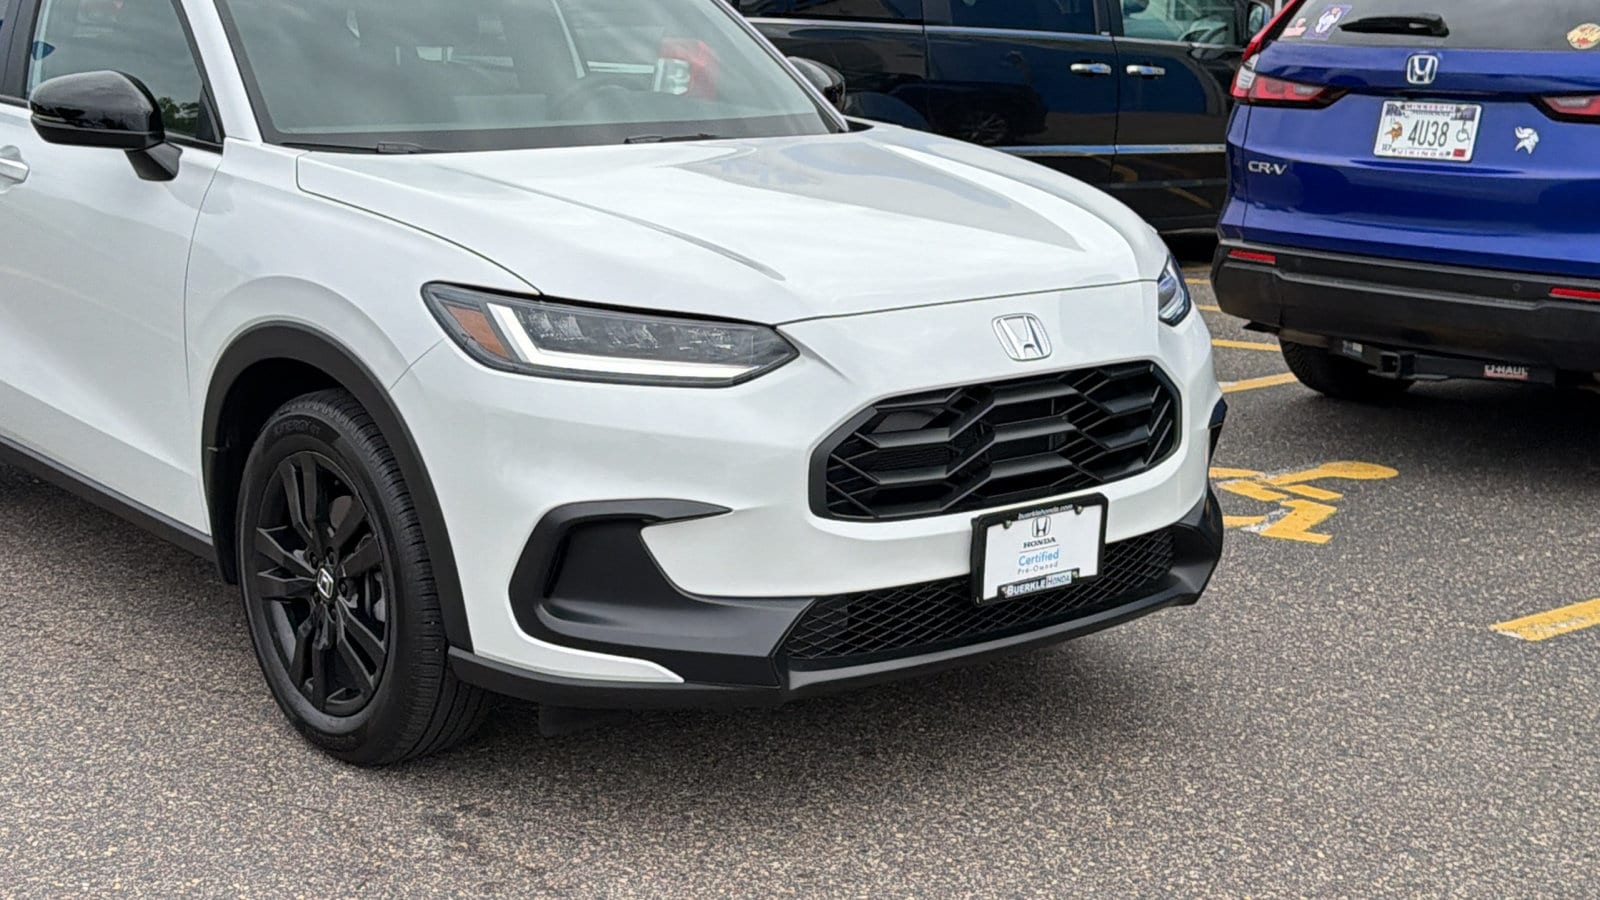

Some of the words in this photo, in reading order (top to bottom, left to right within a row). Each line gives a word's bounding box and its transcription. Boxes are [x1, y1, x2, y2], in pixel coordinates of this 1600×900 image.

[1408, 119, 1450, 147] 4U38
[1248, 160, 1287, 175] CR-V
[1024, 537, 1056, 548] HONDA
[1018, 549, 1060, 567] Certified
[1017, 562, 1059, 575] Pre-Owned
